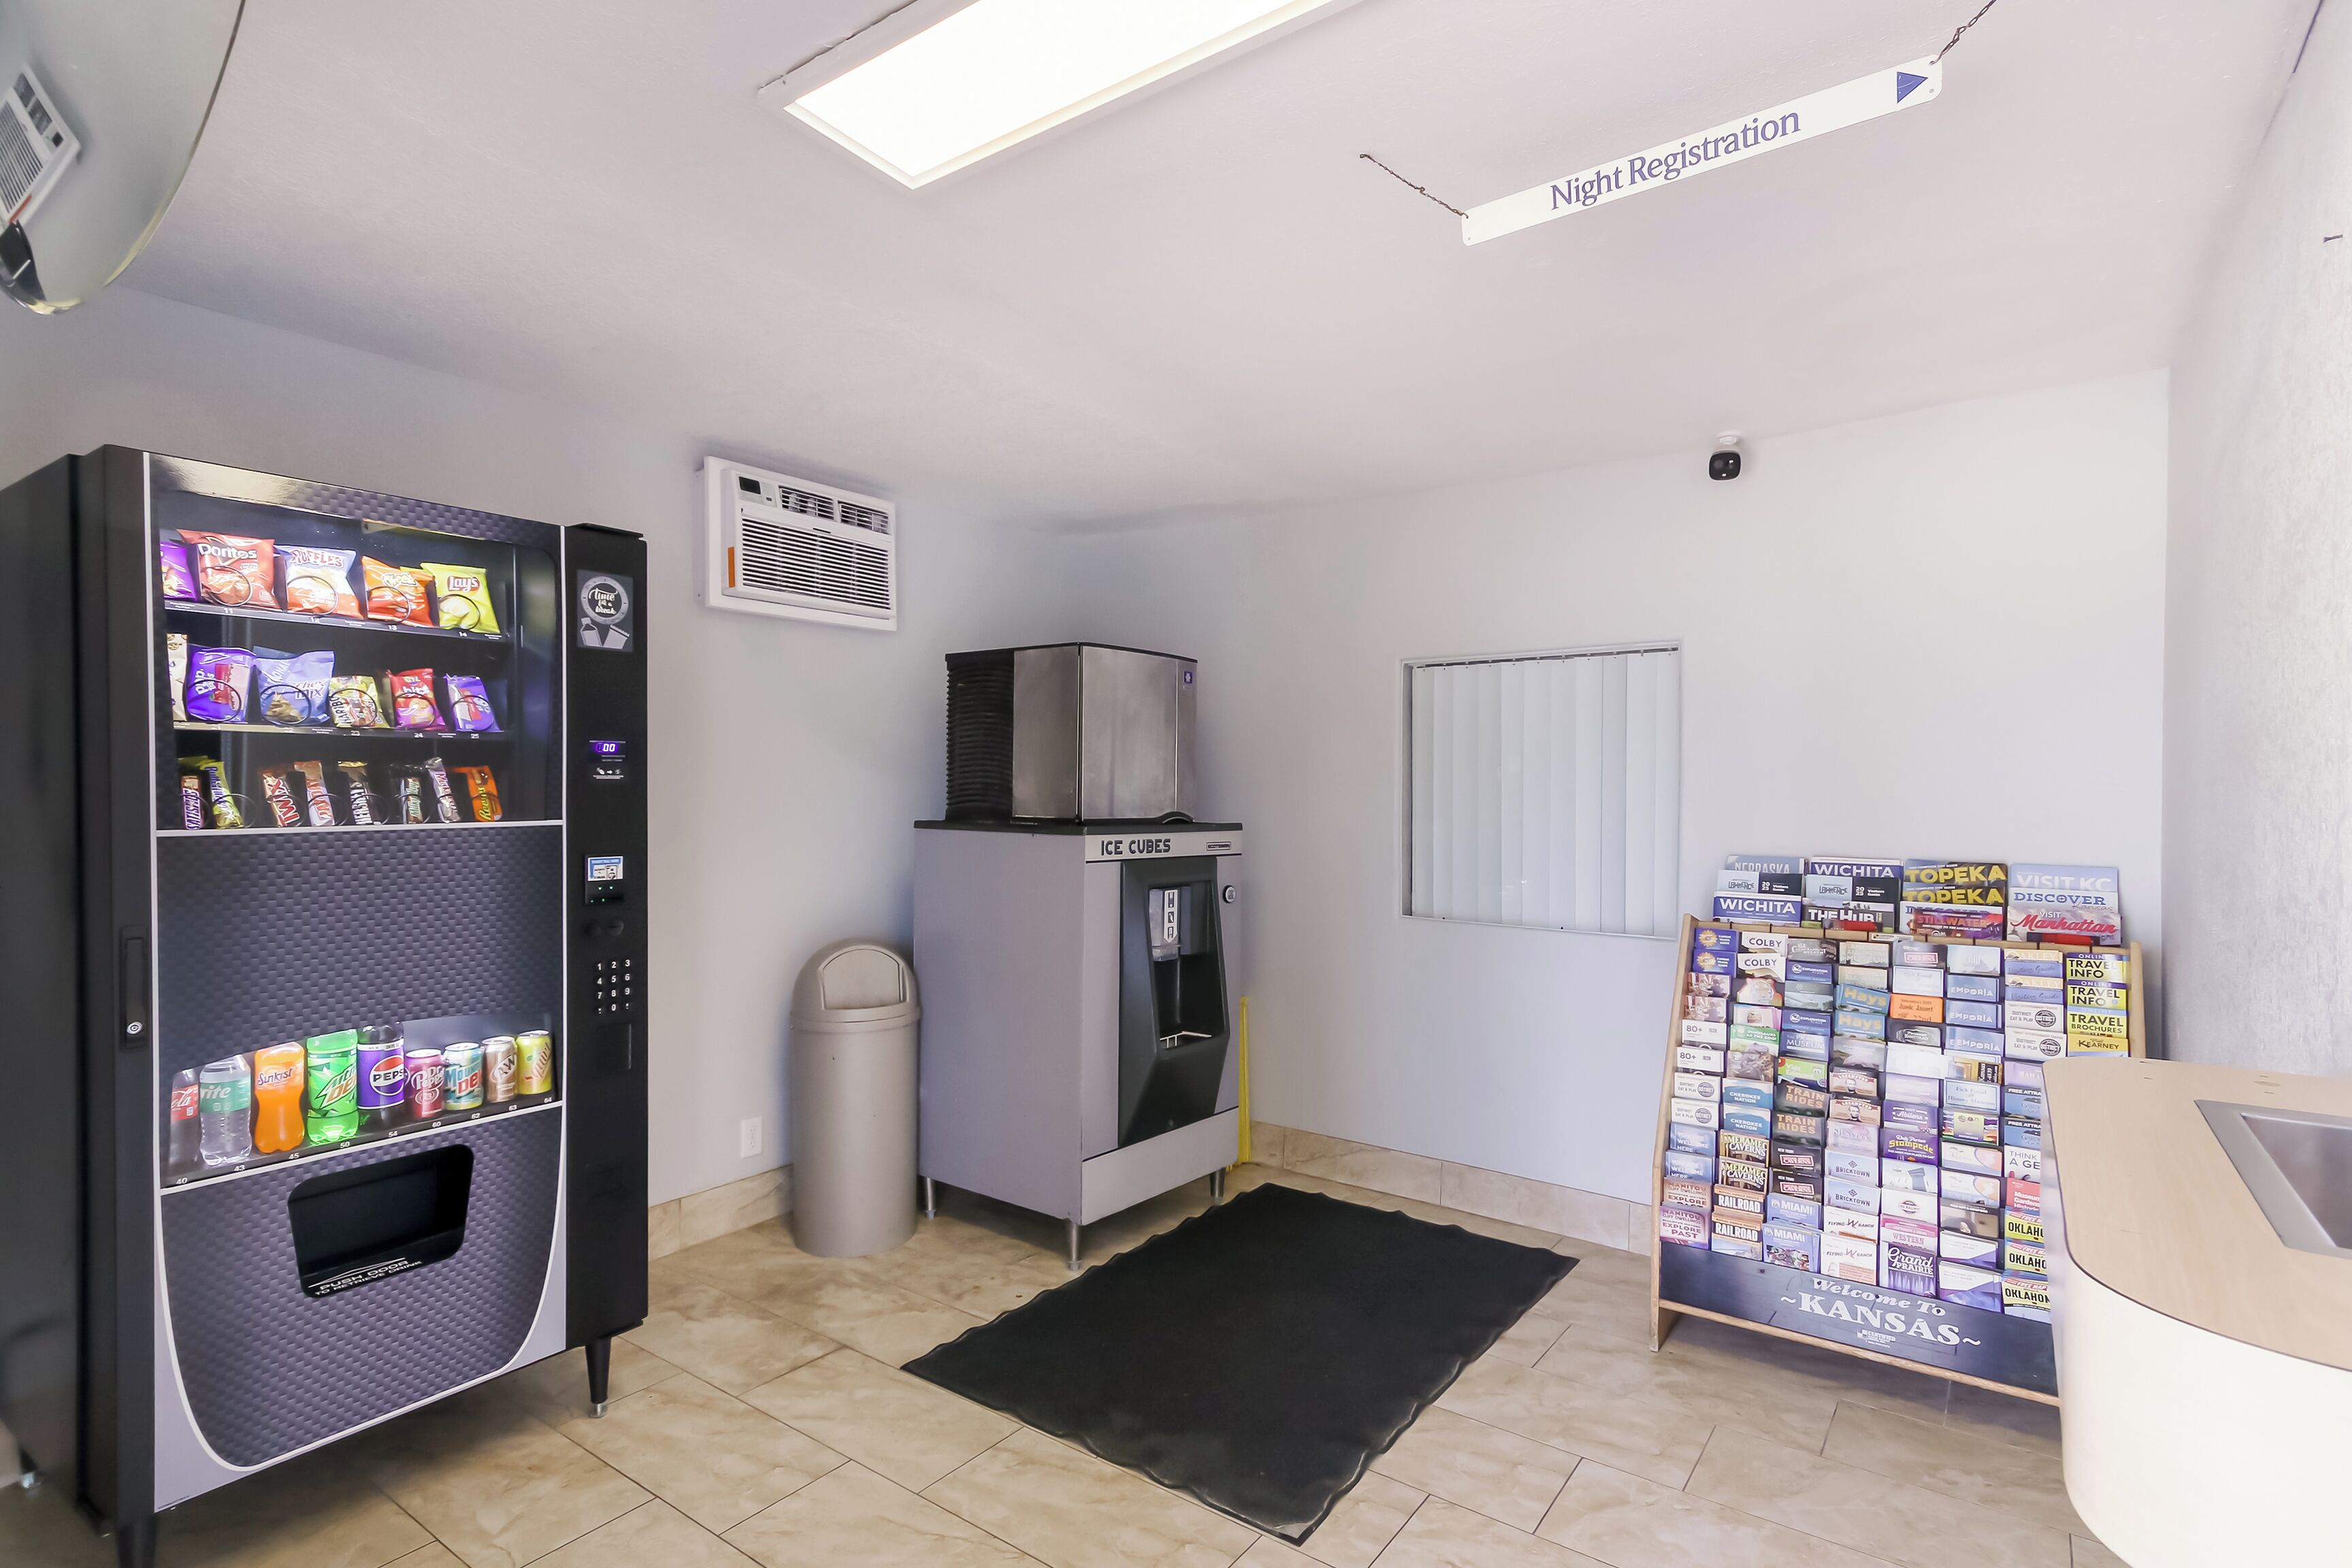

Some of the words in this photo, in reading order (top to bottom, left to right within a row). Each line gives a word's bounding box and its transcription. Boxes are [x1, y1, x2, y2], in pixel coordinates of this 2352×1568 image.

[1551, 169, 1624, 207] Night
[1628, 112, 1801, 180] Registration
[197, 544, 257, 559] Doritos
[290, 549, 344, 568] RUFFLES
[1101, 840, 1123, 855] ICE
[1128, 838, 1171, 854] CUBES
[1814, 864, 1895, 877] WICHITA
[1906, 865, 2007, 883] TOPEKA
[2016, 873, 2075, 889] VISIT
[2079, 876, 2112, 892] KC
[1903, 888, 2004, 904] TOPEKA
[2014, 892, 2106, 906] DISCOVER
[1720, 898, 1795, 914] WICHITA
[2039, 911, 2061, 919] VISIT
[2010, 914, 2117, 934] Manhattan
[1749, 938, 1782, 947] COLBY
[1744, 959, 1778, 967] COLBY
[2070, 969, 2104, 979] INFO
[1844, 987, 1886, 1007] Hays
[1950, 987, 1994, 997] EMPORIA
[2071, 986, 2120, 998] TRAVEL
[2072, 996, 2106, 1007] INFO
[1839, 1015, 1882, 1030] Hays
[1950, 1012, 1993, 1023] EMPORIA
[2070, 1014, 2123, 1027] TRAVEL
[2072, 1024, 2122, 1034] BROCHURES
[1786, 1039, 1825, 1049] MUSEUM
[1957, 1039, 2001, 1051] EMPORIA
[2078, 1039, 2119, 1050] KEARNEY
[258, 1067, 294, 1086] Sunkist
[1729, 1092, 1761, 1100] CHEROKEE
[1786, 1085, 1825, 1101] TRAIN
[1786, 1093, 1824, 1108] RIDES
[1730, 1118, 1763, 1127] CHEROKEE
[1776, 1113, 1816, 1127] TRAIN
[1778, 1122, 1816, 1134] RIDES
[1729, 1143, 1766, 1157] CAVERNS
[1889, 1139, 1933, 1154] Stampede
[2010, 1150, 2037, 1160] THINK
[2009, 1158, 2019, 1166] A
[1835, 1166, 1870, 1177] BRICKTOWN
[1727, 1171, 1764, 1186] CAVERNS
[1668, 1181, 1706, 1192] MANITOU
[1668, 1195, 1707, 1206] EXPLORE
[1718, 1195, 1760, 1213] RAILROAD
[1835, 1194, 1870, 1207] BRICKTOWN
[1781, 1200, 1813, 1215] MIAMI
[1663, 1210, 1700, 1220] MANITOU
[1663, 1222, 1701, 1234] EXPLORE
[1847, 1218, 1859, 1229] W
[1671, 1229, 1698, 1239] PAST
[1715, 1223, 1758, 1241] RAILROAD
[1774, 1229, 1806, 1242] MIAMI
[1893, 1233, 1925, 1245] WESTERN
[1846, 1247, 1857, 1259] W
[1888, 1247, 1933, 1270] Grand
[389, 1260, 423, 1273] DRINK
[1896, 1260, 1933, 1274] PRAIRIE
[320, 1275, 362, 1290] PUSH
[368, 1260, 409, 1277] DOOR
[1813, 1277, 1910, 1309] Welcome
[1916, 1301, 1946, 1317] To
[1799, 1292, 1960, 1346] KANSAS
